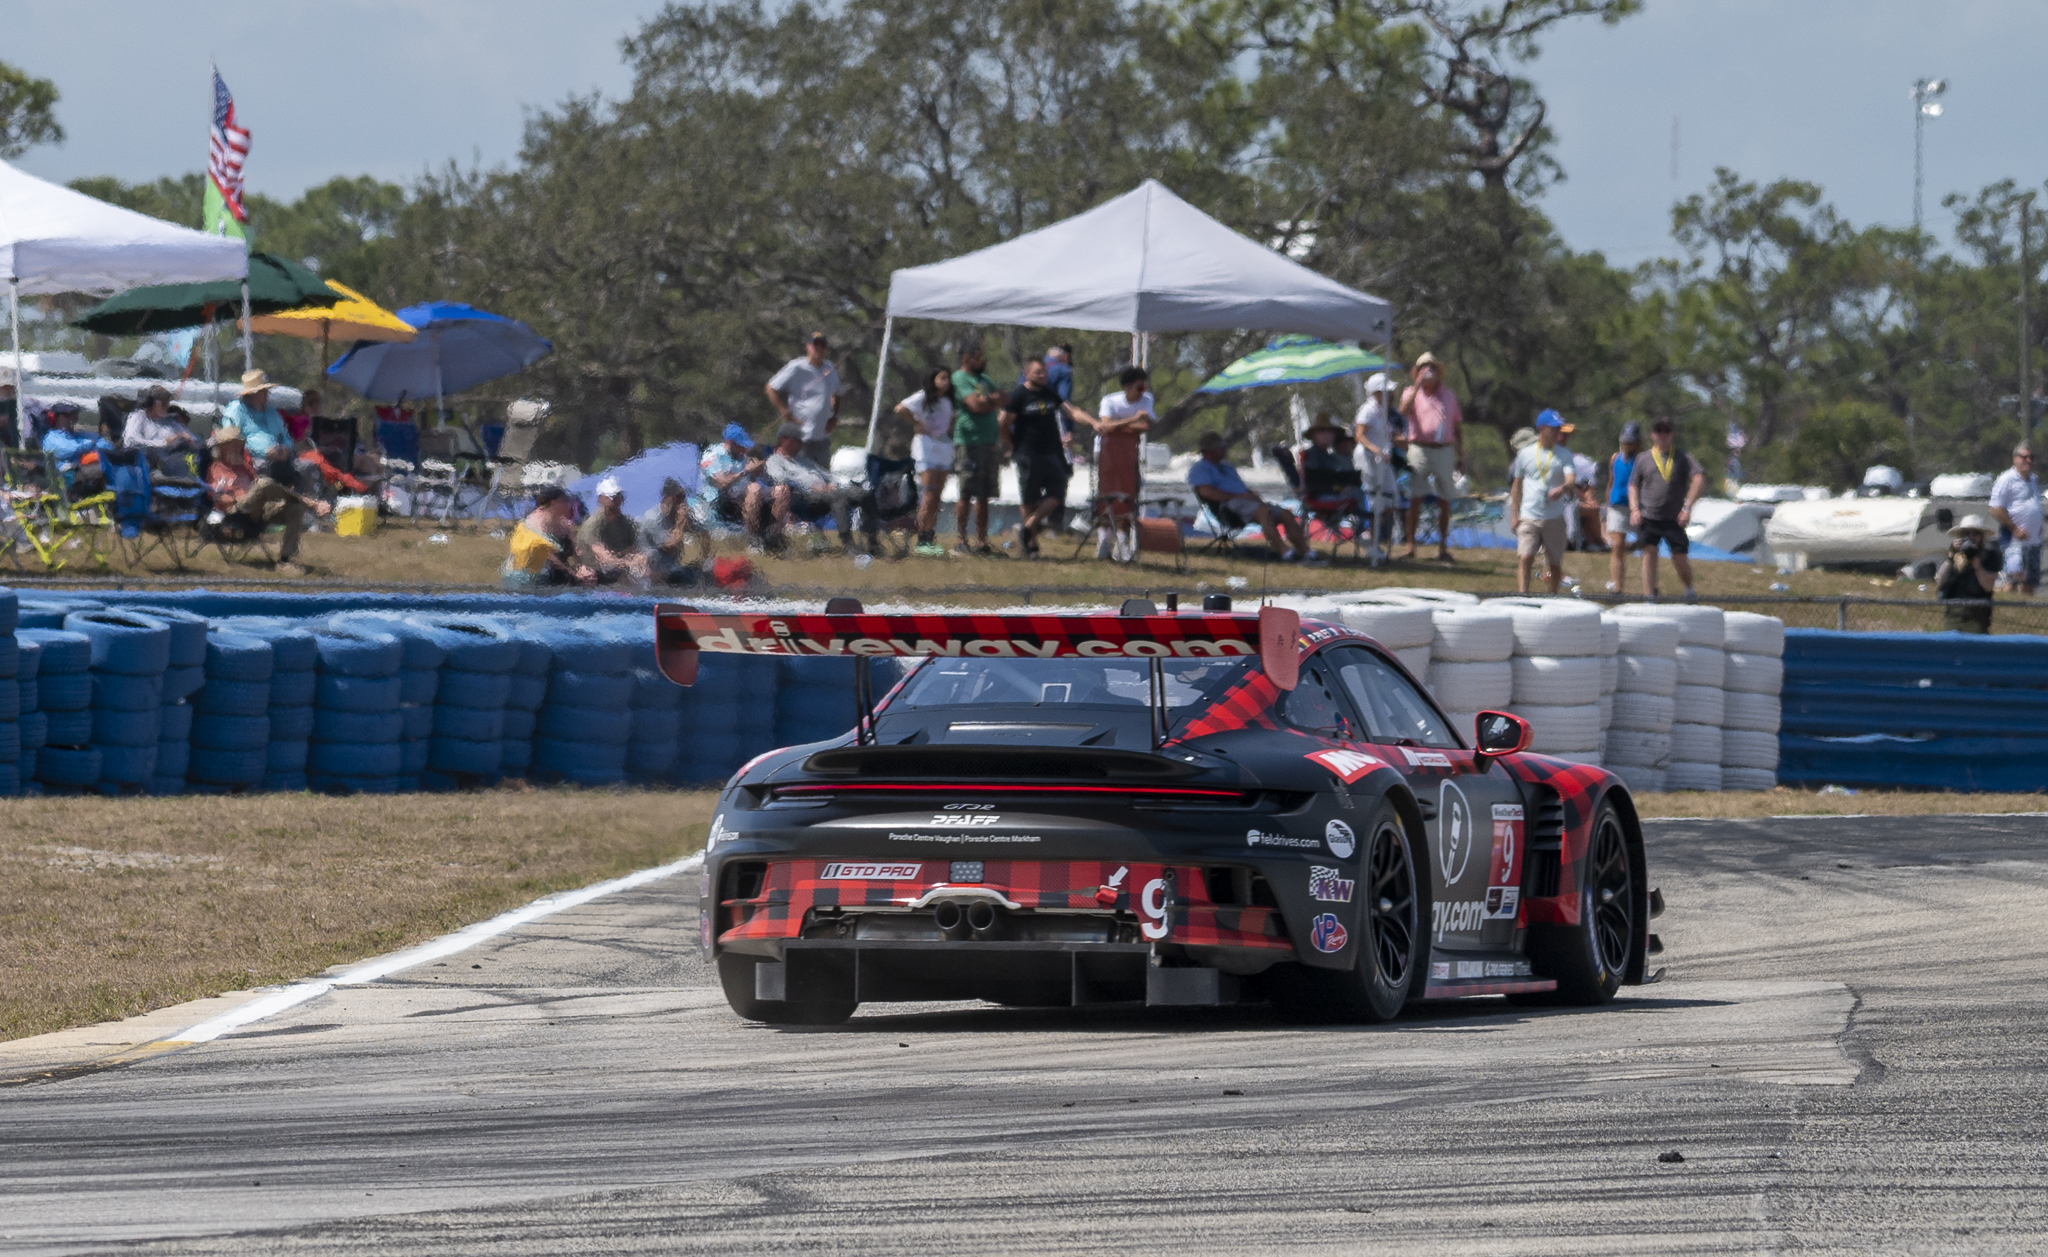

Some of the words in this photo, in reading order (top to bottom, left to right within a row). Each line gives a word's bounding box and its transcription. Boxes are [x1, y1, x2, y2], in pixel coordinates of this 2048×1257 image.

[1318, 749, 1386, 777] MO
[930, 814, 1001, 825] PFAFF
[889, 833, 913, 842] Porsche
[913, 834, 934, 842] Centre
[935, 834, 961, 844] Vaughan
[965, 834, 989, 843] Porsche
[989, 835, 1011, 843] Centre
[1011, 834, 1041, 843] Markham
[1261, 832, 1320, 848] feldrives.com
[1501, 825, 1515, 884] 9
[841, 866, 876, 877] GTD
[878, 866, 916, 877] PRO
[1317, 879, 1354, 901] KW
[1141, 878, 1169, 940] 9
[1313, 913, 1338, 951] VP
[1432, 900, 1485, 943] ay.com
